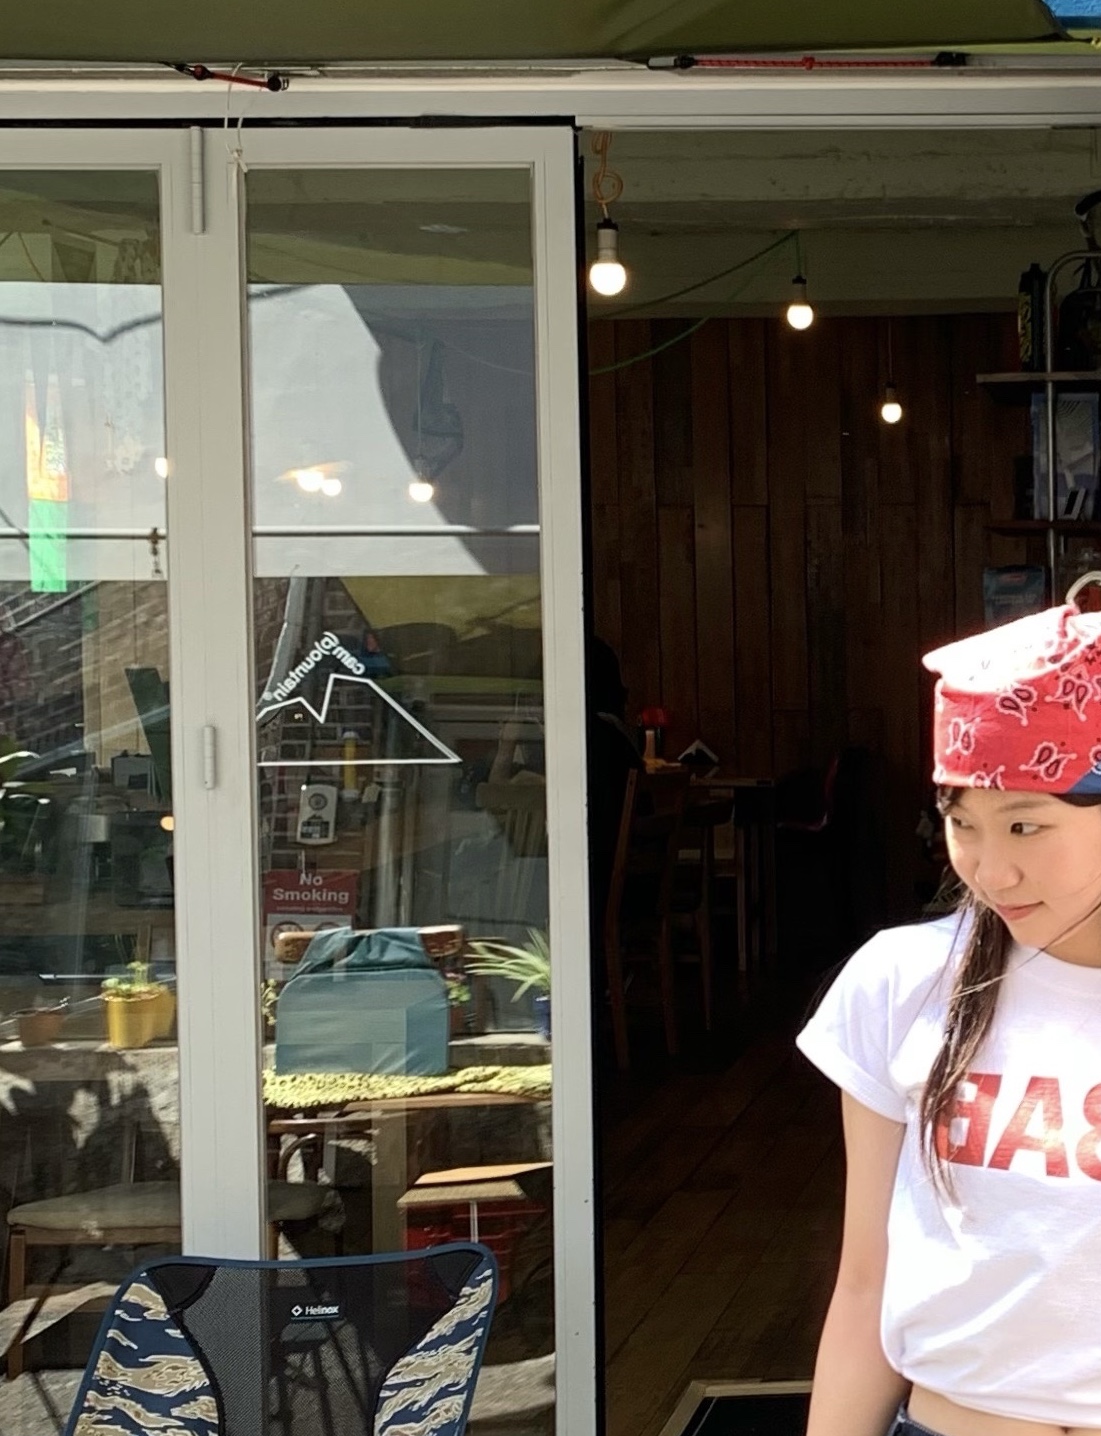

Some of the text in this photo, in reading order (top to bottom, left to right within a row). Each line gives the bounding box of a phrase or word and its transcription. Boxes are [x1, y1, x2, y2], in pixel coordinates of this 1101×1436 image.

[299, 873, 323, 886] No
[273, 888, 349, 904] Smoking
[305, 1305, 340, 1315] Helinox
